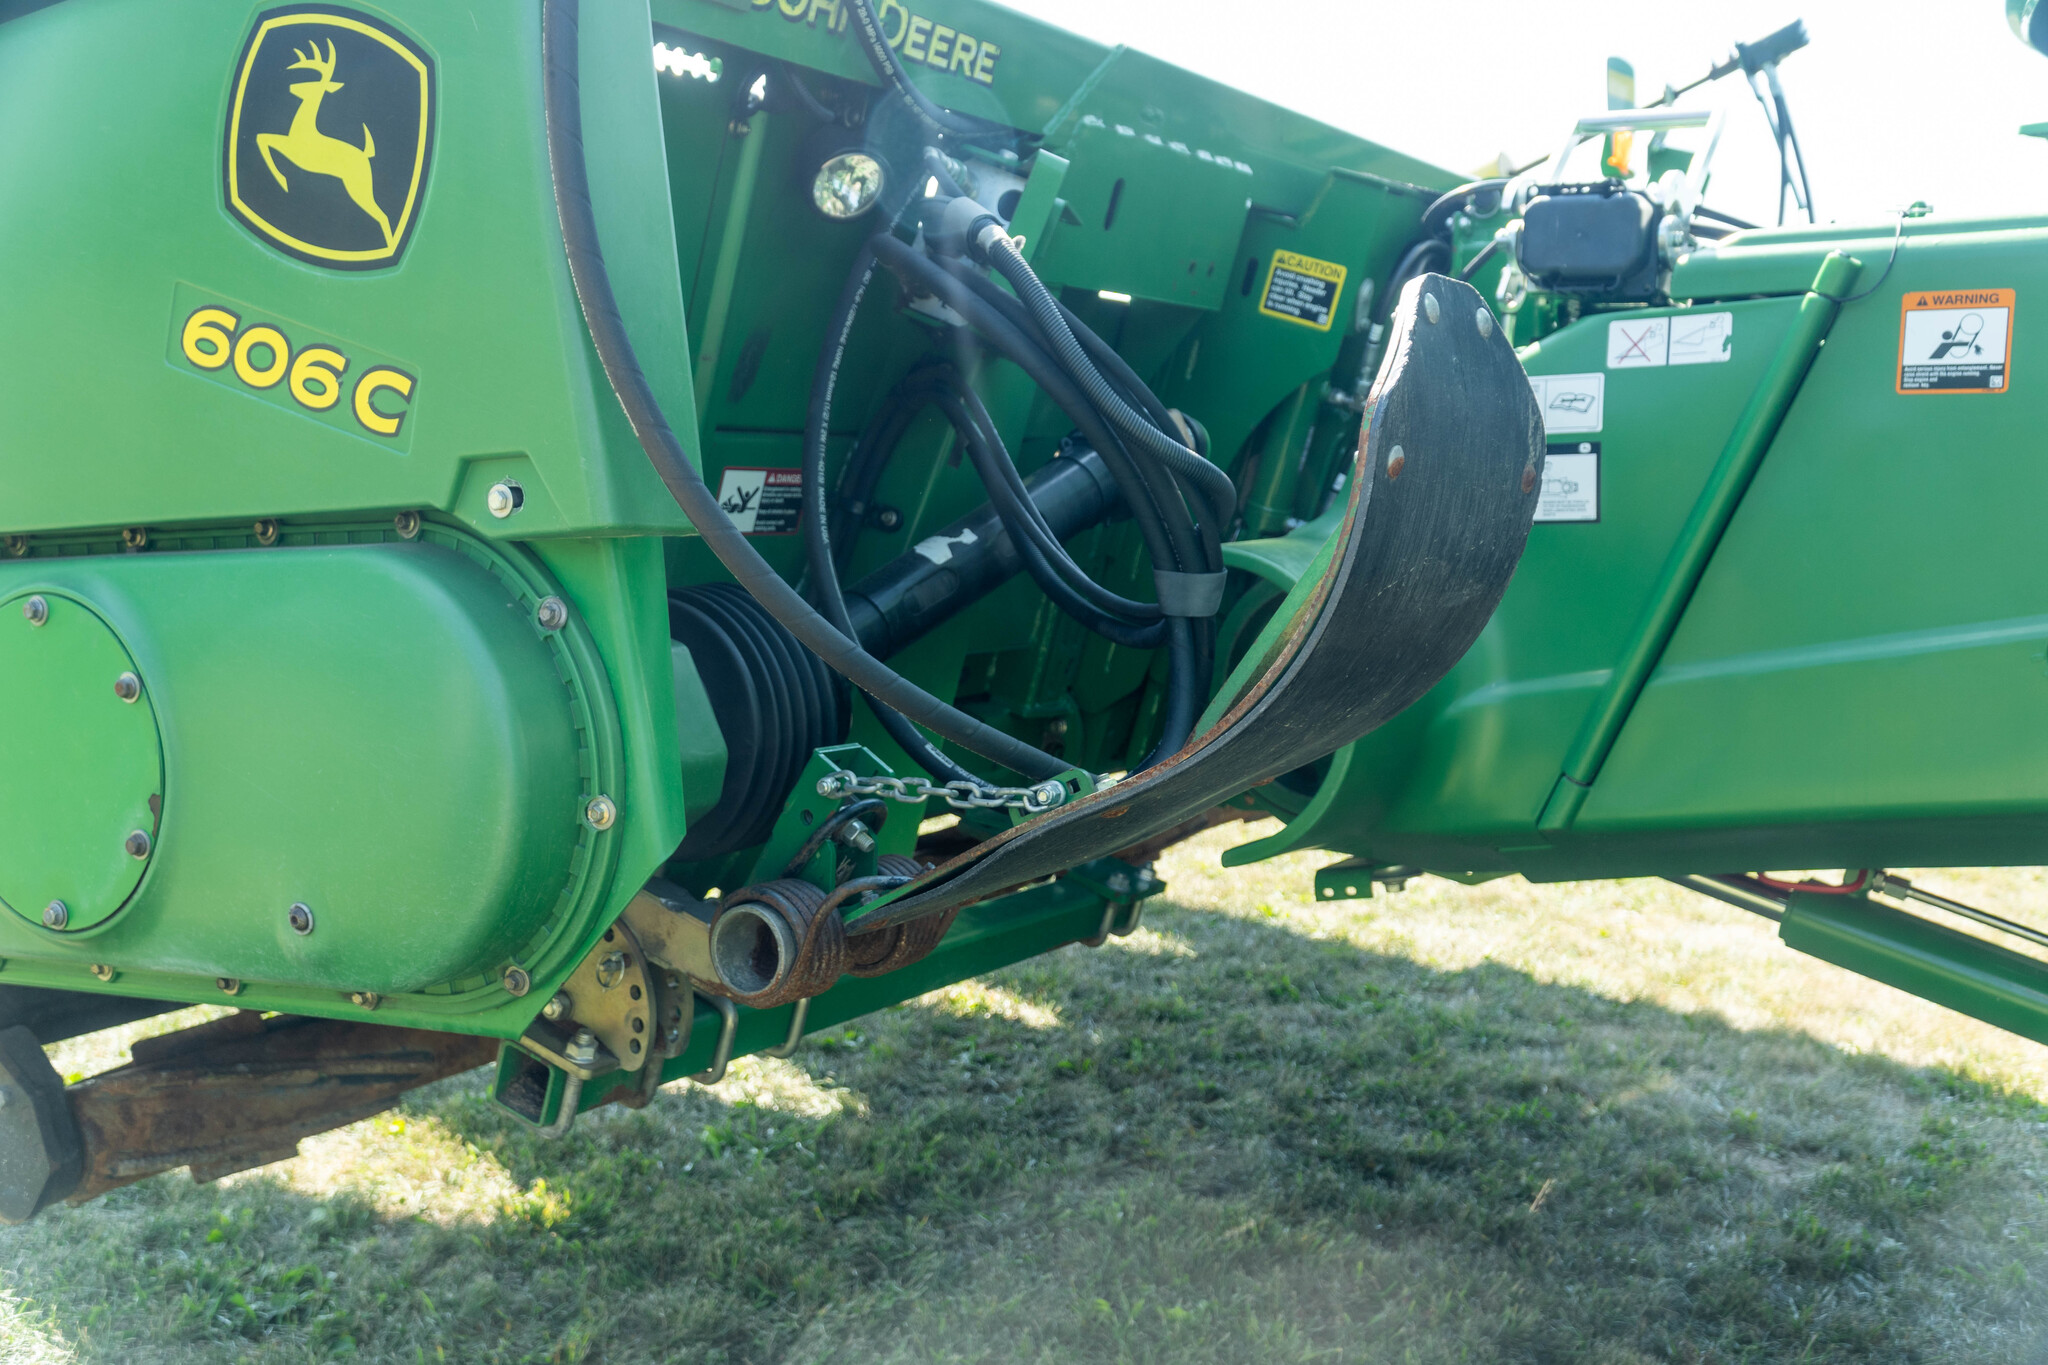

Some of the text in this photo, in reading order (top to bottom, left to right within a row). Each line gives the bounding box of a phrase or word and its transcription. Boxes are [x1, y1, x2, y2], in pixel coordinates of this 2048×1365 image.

[879, 0, 1000, 86] DEERE
[1287, 255, 1343, 279] CAUTION
[1932, 293, 2000, 305] WARNING
[776, 473, 802, 484] DANGE
[818, 487, 826, 513] MADE
[819, 514, 828, 525] IN
[821, 526, 830, 544] USA
